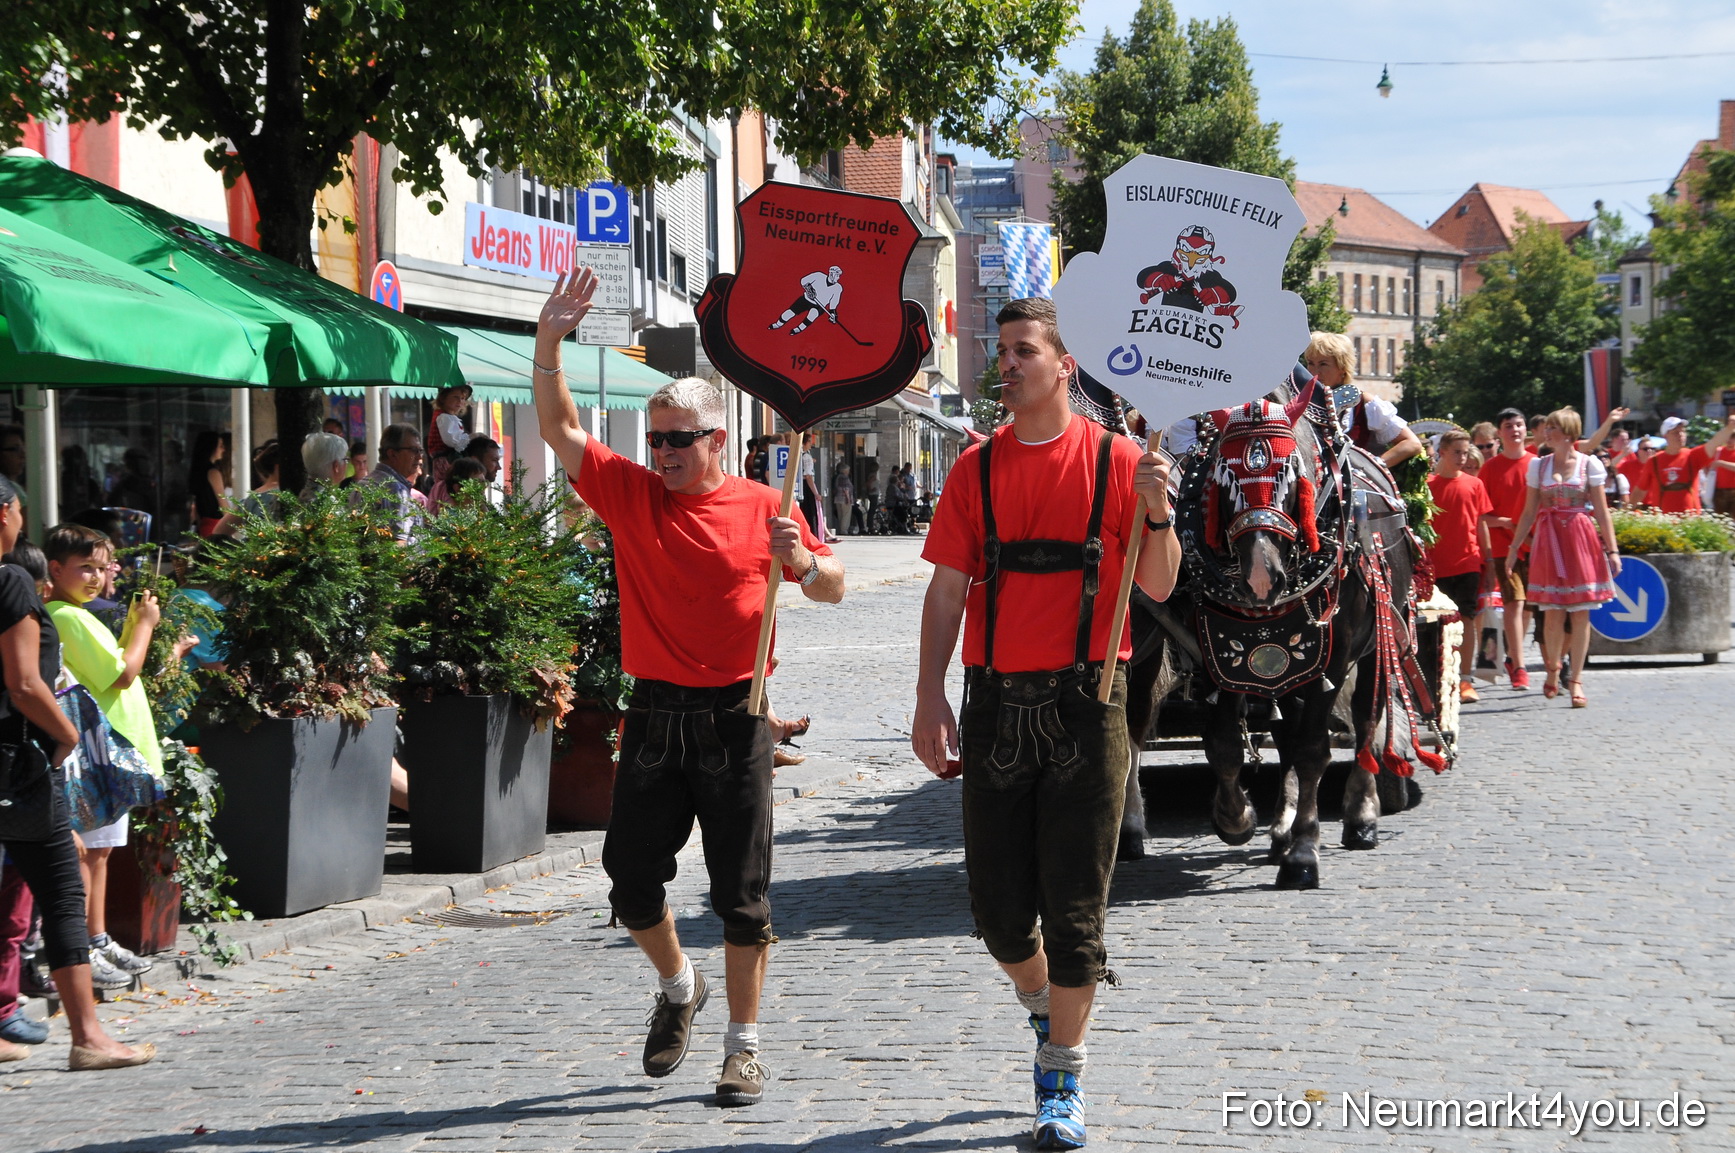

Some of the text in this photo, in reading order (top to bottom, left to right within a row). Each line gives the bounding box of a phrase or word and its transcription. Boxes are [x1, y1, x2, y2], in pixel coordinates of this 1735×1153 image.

[588, 188, 617, 235] P
[759, 201, 900, 236] Eissportfreunde
[1126, 185, 1284, 230] EISLAUFSCHULE FELIX
[471, 210, 577, 276] Jeans Wölf
[765, 223, 887, 255] Neumarkt e. V.
[587, 252, 619, 261] nur mit
[591, 272, 623, 283] erktags
[1127, 309, 1225, 349] EAGLES
[1151, 309, 1208, 325] NEUMARKT
[791, 355, 828, 373] 1999
[1147, 356, 1232, 383] Lebenshilfe
[1145, 370, 1204, 389] Neumarkt e.V.
[780, 451, 789, 465] P
